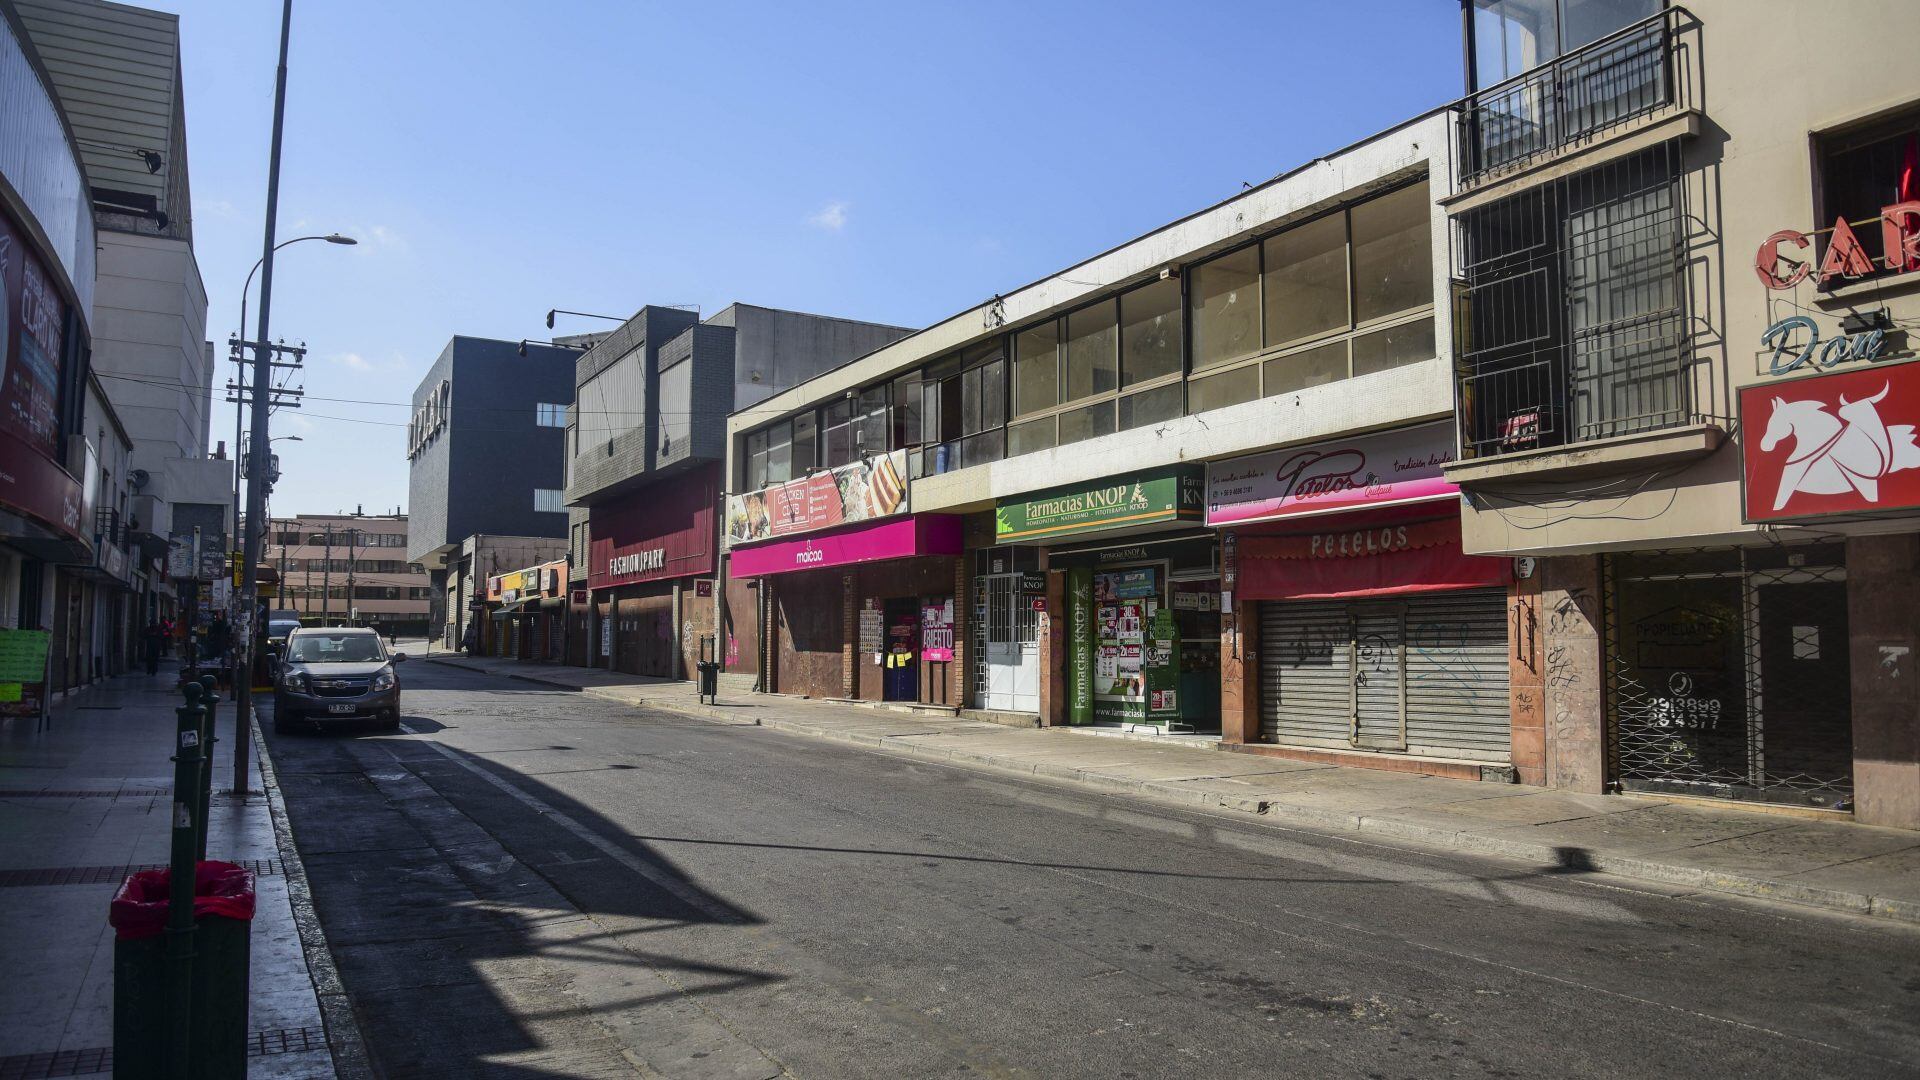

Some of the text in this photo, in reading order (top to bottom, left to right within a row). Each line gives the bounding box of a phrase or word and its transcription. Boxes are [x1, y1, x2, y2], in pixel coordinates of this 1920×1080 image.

[1025, 484, 1127, 519] Farmacias KNOP
[1023, 580, 1044, 590] KNOP
[923, 628, 953, 649] ABIERTO
[1074, 602, 1085, 644] KNOP
[1074, 646, 1085, 710] Farmacias
